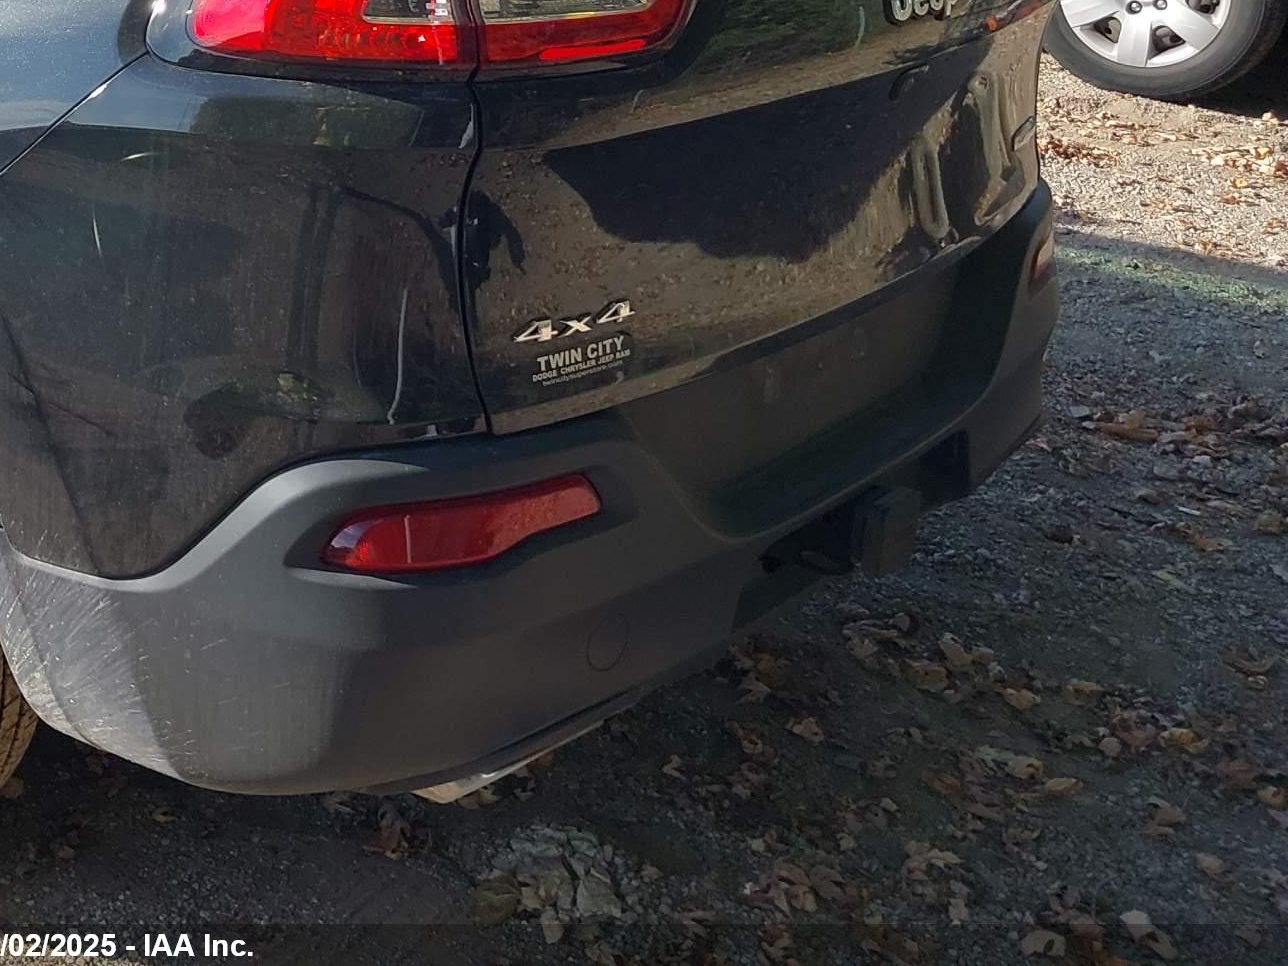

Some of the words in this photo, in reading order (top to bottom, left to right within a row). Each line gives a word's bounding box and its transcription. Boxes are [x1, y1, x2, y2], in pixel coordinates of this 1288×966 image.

[532, 370, 558, 382] DODGE
[560, 359, 596, 375] CHRYSLER
[598, 354, 614, 366] JEEP
[616, 349, 631, 360] RAM
[537, 347, 582, 372] TWIN
[587, 336, 624, 359] CITY
